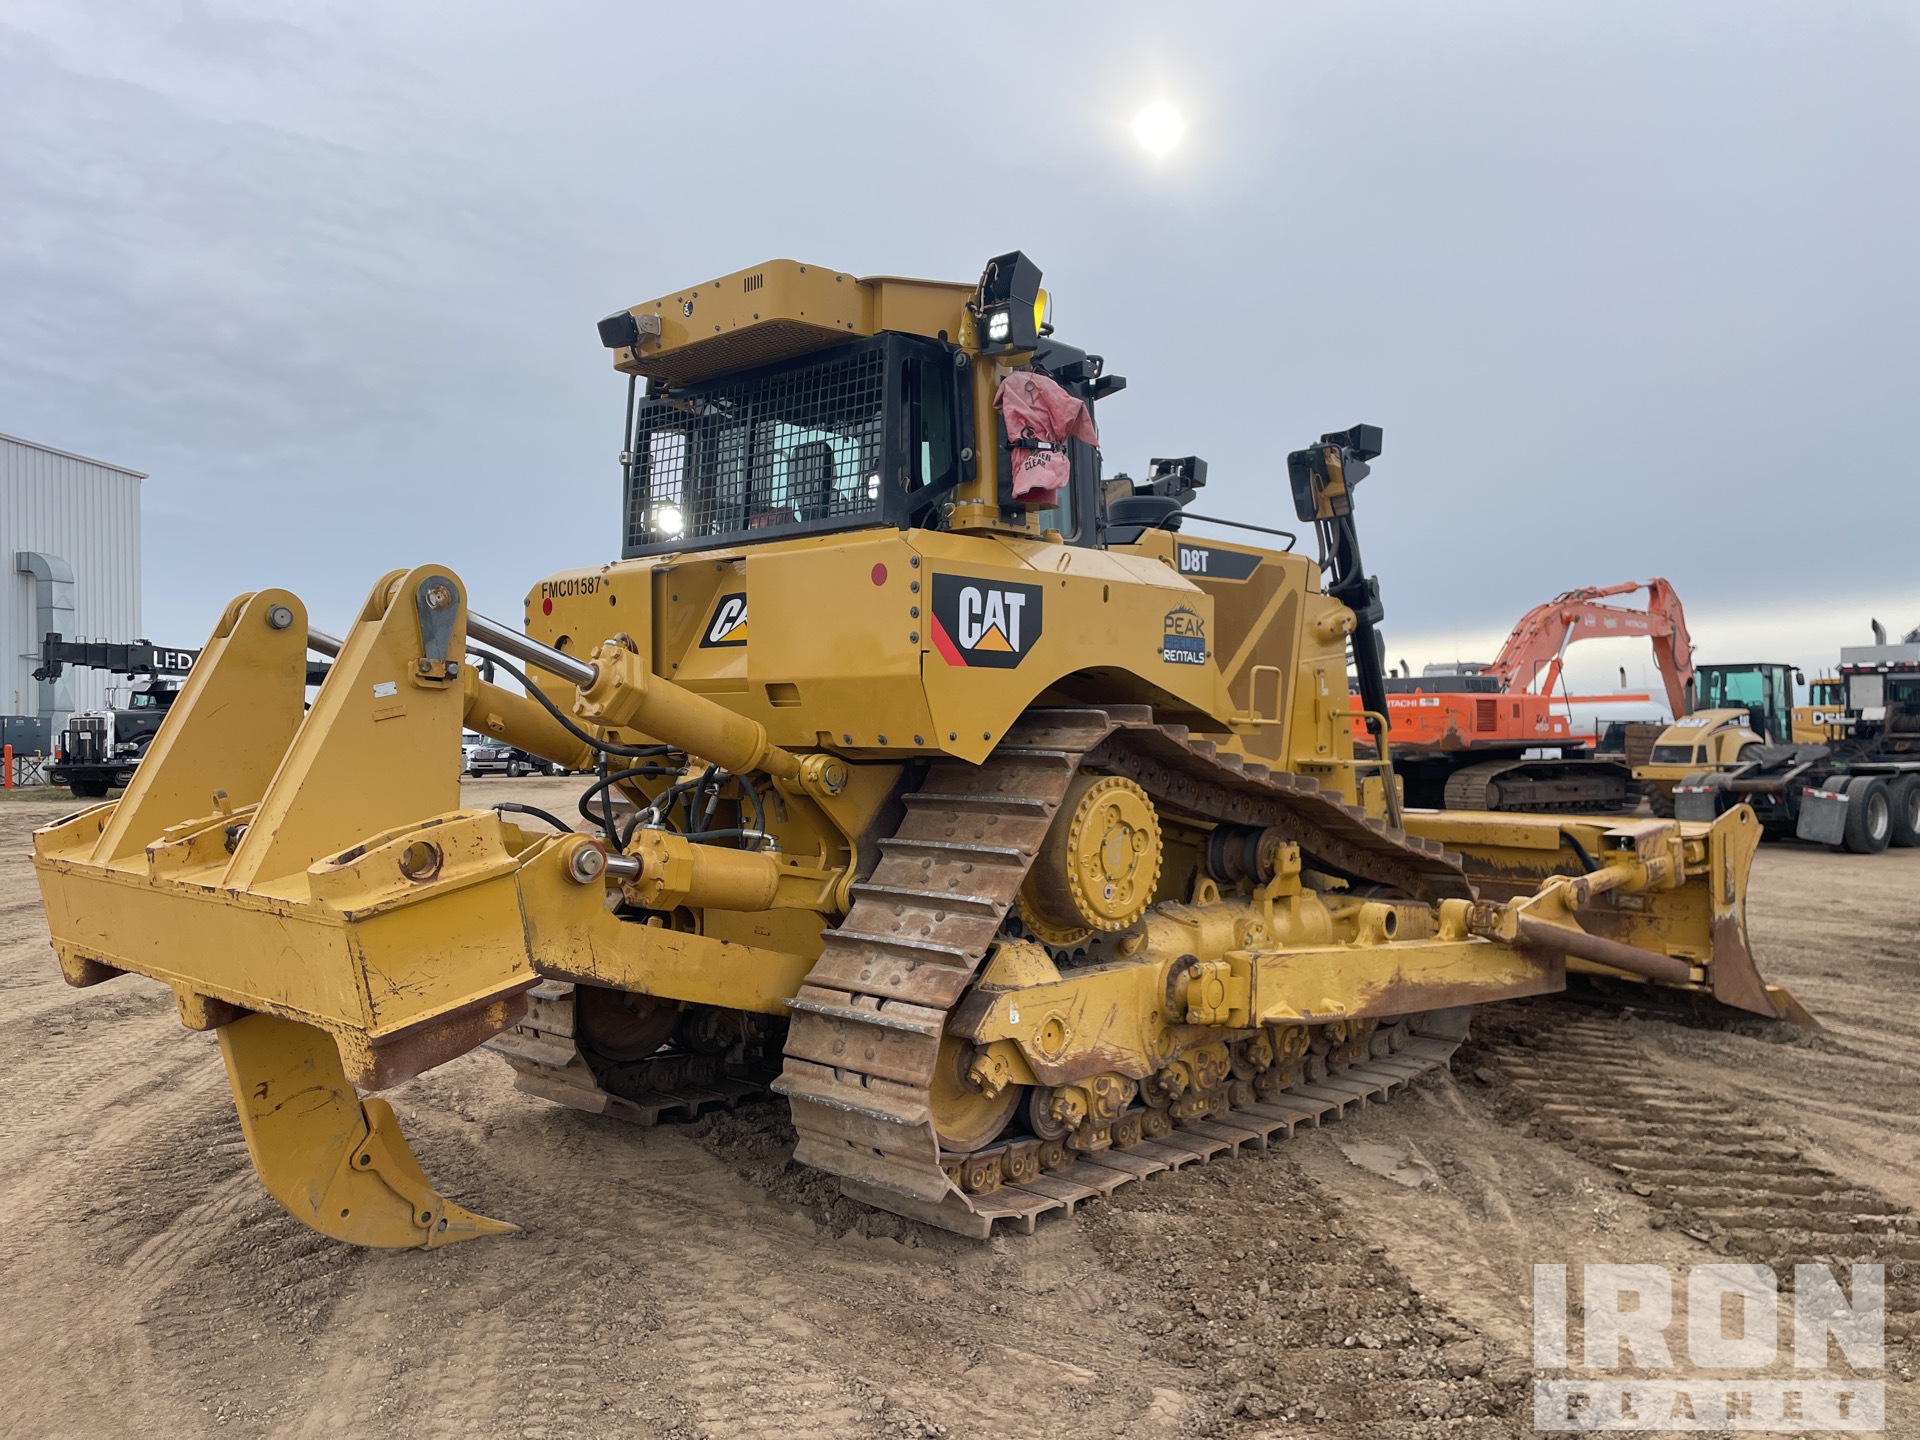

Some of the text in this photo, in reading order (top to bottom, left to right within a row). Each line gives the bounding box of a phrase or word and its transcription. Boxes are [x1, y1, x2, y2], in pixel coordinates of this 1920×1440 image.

[1180, 548, 1209, 573] D8T
[541, 575, 602, 599] FMC01587
[958, 586, 1026, 653] CAT
[1164, 615, 1205, 637] PEAK
[153, 650, 193, 669] LED
[1163, 649, 1205, 663] RENTALS
[1387, 699, 1417, 708] ITACHI
